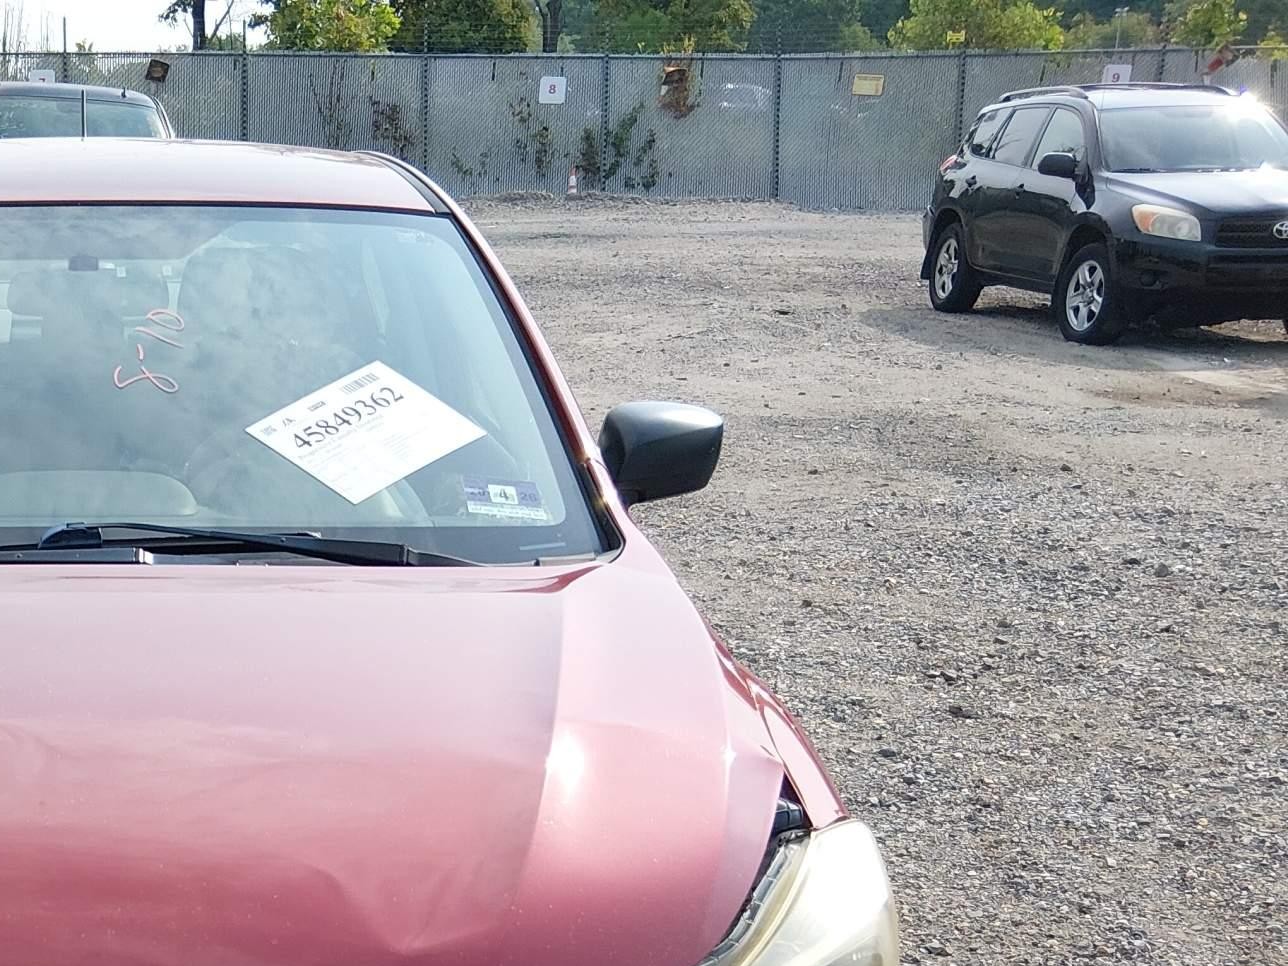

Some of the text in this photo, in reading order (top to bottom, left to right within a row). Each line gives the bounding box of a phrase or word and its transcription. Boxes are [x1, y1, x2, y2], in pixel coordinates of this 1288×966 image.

[1112, 72, 1120, 82] 9
[548, 84, 557, 95] 8
[293, 386, 405, 450] 45849362
